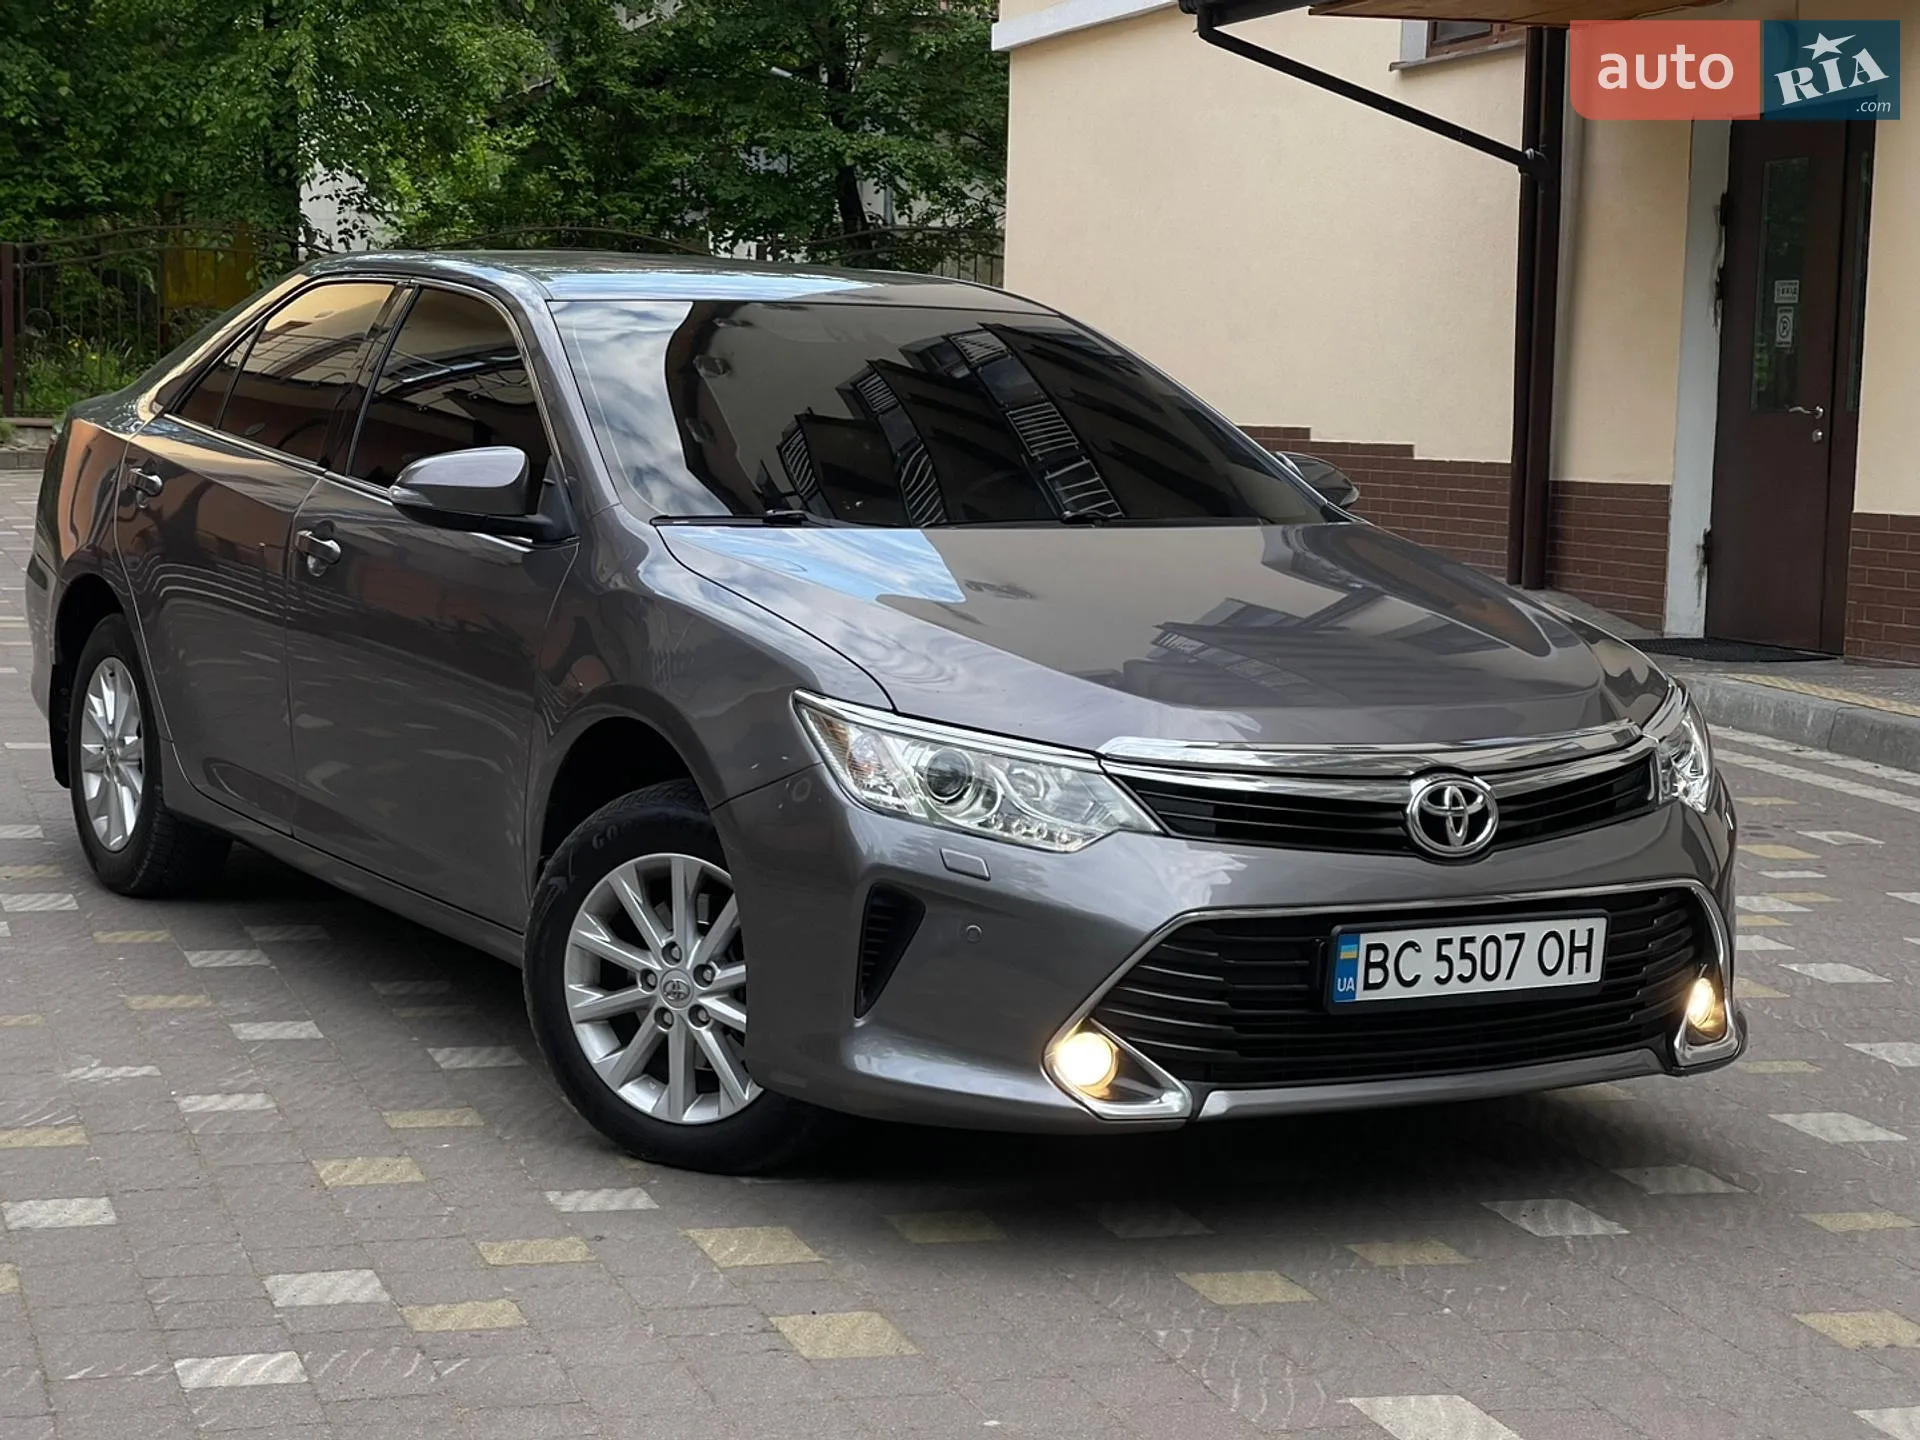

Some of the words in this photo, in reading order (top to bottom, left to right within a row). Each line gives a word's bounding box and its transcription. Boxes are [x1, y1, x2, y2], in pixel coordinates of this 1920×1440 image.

[1363, 940, 1422, 992] BC
[1434, 932, 1526, 985] 5507
[1537, 927, 1595, 977] OH
[1337, 977, 1355, 992] UA
